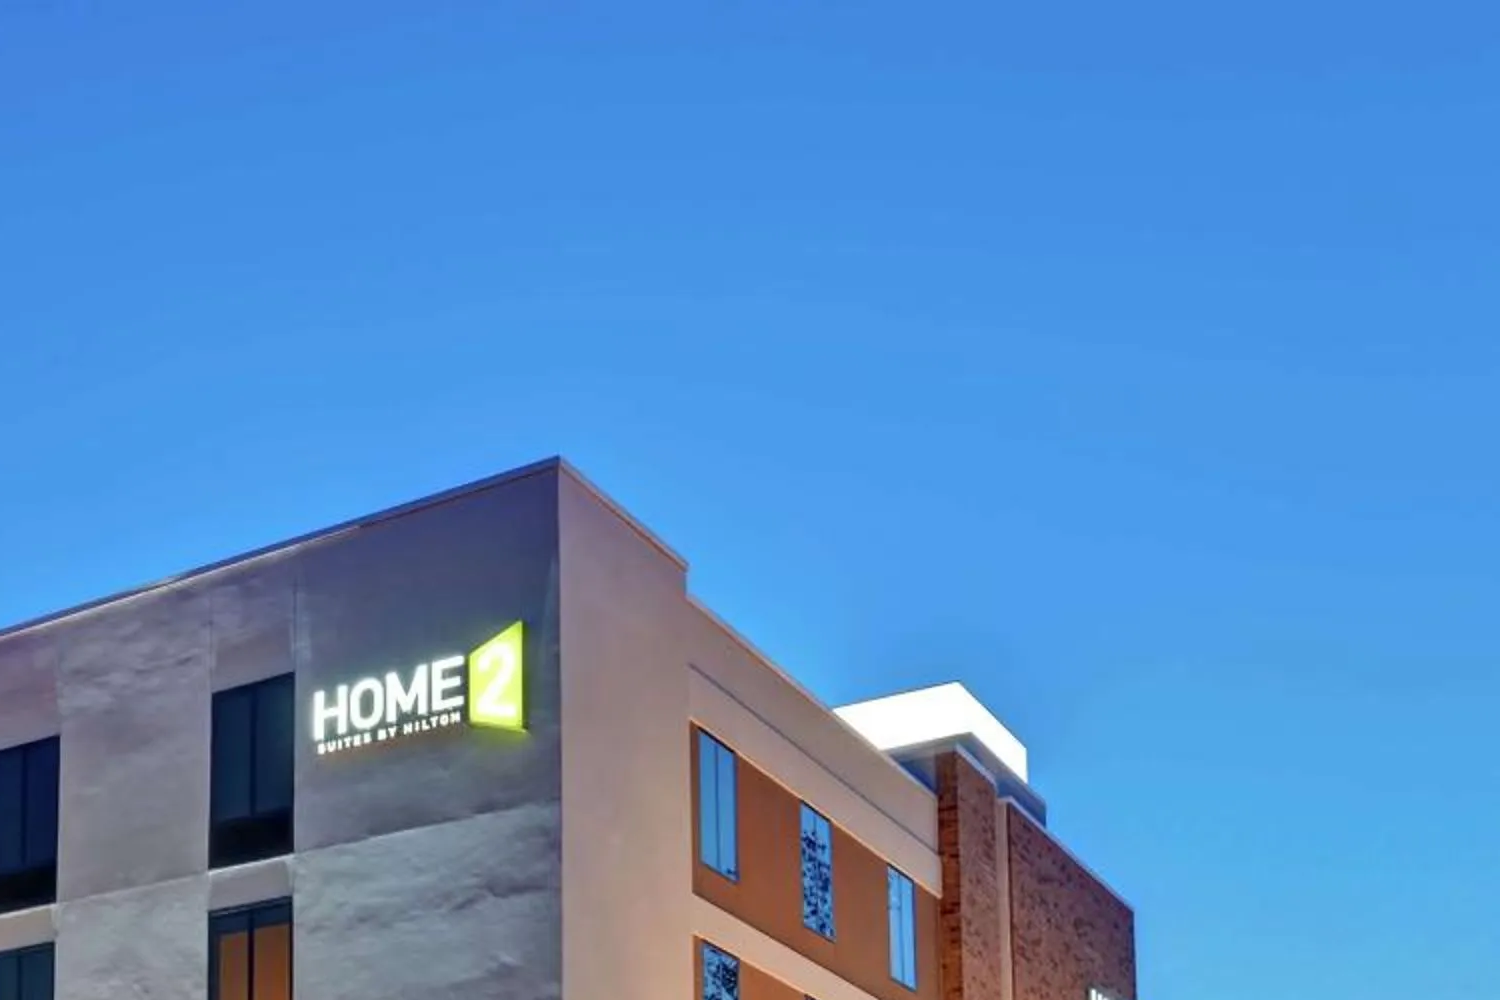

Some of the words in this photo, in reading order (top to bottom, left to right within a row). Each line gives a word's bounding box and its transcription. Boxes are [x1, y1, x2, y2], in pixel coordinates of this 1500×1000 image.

[313, 654, 465, 742] HOME
[477, 641, 518, 718] 2
[317, 731, 373, 756] SUITES
[377, 725, 398, 741] BY
[403, 711, 461, 735] HILTON
